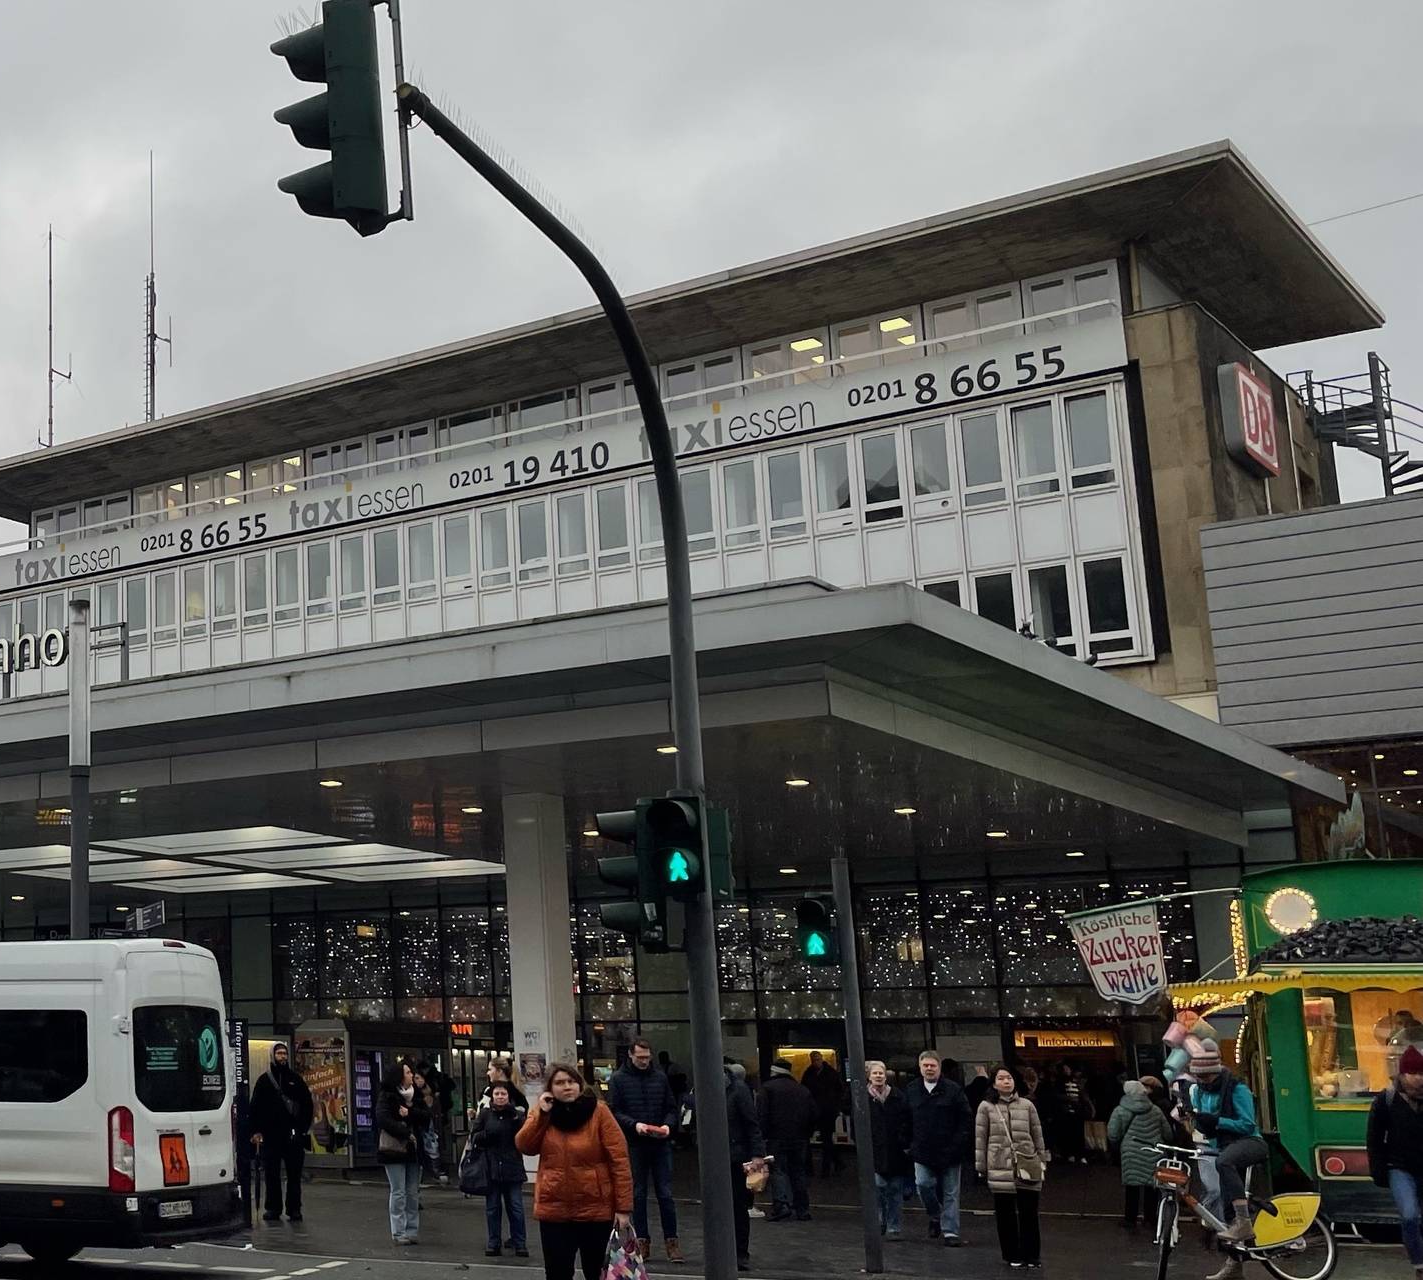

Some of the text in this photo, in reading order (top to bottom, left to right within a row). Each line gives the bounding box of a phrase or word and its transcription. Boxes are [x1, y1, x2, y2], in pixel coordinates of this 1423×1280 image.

[1241, 380, 1275, 457] DB
[140, 532, 175, 552] 0201
[179, 528, 193, 553] 8
[200, 520, 230, 549] 66
[238, 513, 267, 542] 55
[449, 465, 494, 489] 0201
[503, 456, 540, 488] 19
[549, 441, 610, 477] 410
[847, 379, 907, 407] 0201
[914, 373, 938, 404] 8
[950, 359, 1001, 397] 66
[1015, 345, 1066, 386] 55
[1077, 912, 1151, 936] Köstliche
[1081, 927, 1159, 967] Zucker
[1101, 960, 1160, 994] watte
[235, 1021, 243, 1083] Information
[524, 1031, 538, 1040] WC
